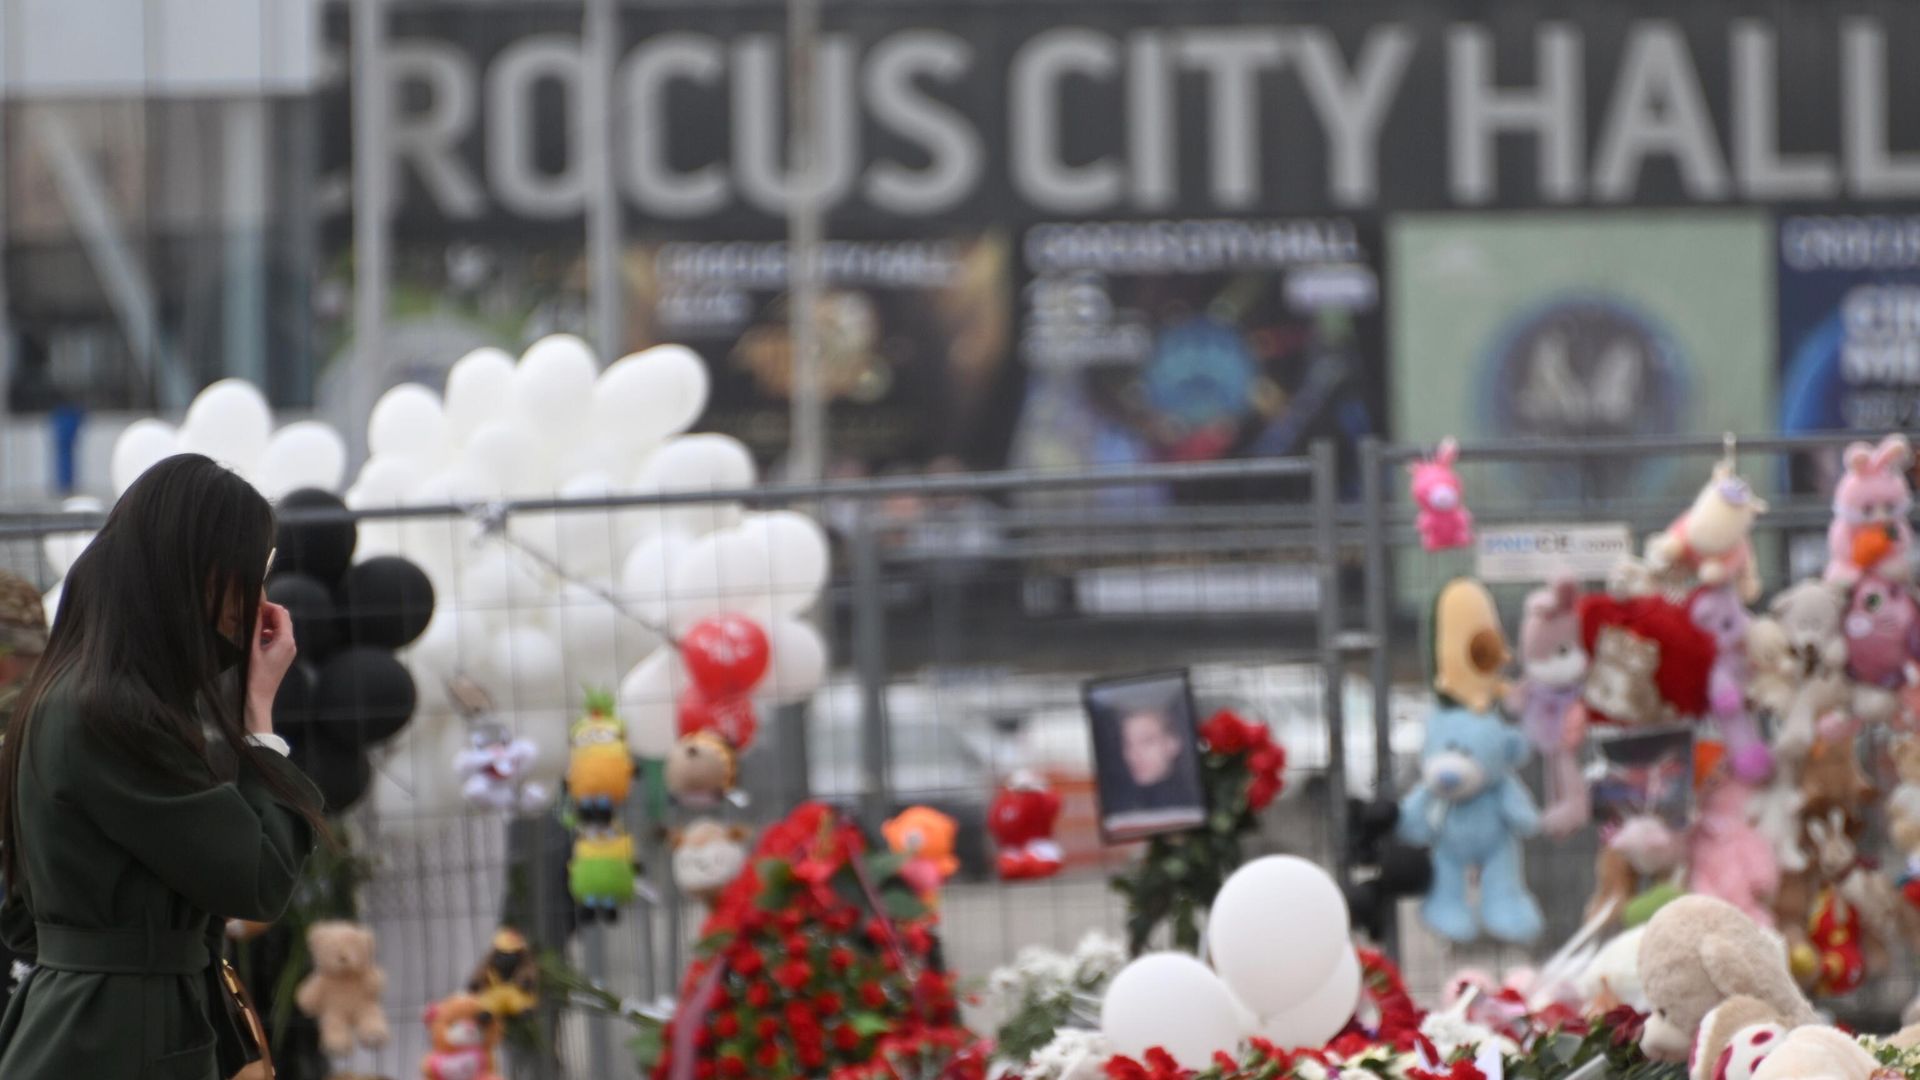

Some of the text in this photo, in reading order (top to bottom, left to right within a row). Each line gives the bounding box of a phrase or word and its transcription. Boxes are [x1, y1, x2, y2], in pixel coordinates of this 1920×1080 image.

[310, 18, 1920, 222] ROCUS CITY HALL
